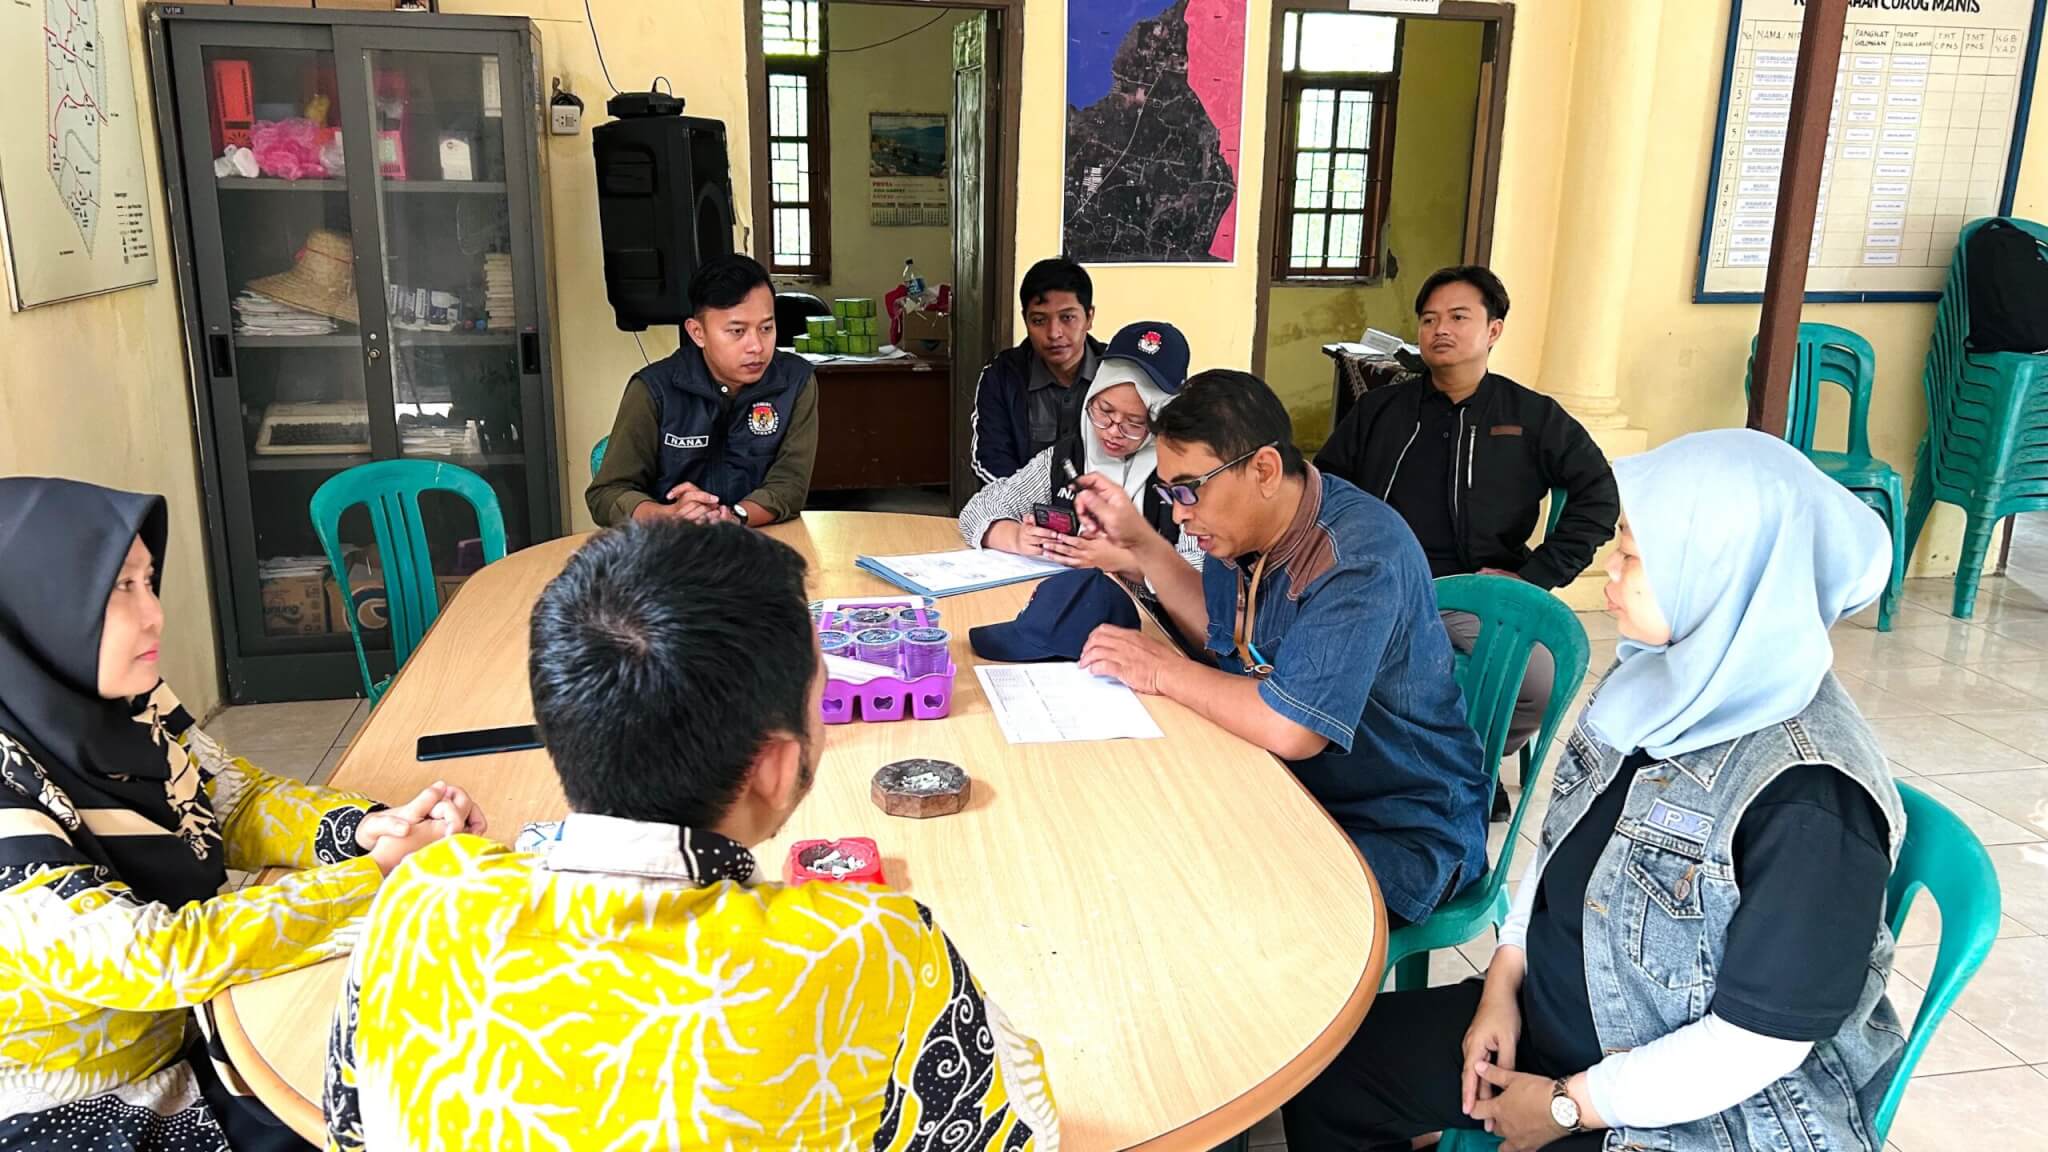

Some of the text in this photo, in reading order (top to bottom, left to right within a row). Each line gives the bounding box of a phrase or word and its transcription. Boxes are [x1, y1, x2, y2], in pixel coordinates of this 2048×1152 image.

[1881, 0, 1928, 11] CURUG
[1932, 0, 1980, 13] MANIS
[670, 437, 703, 447] NANA
